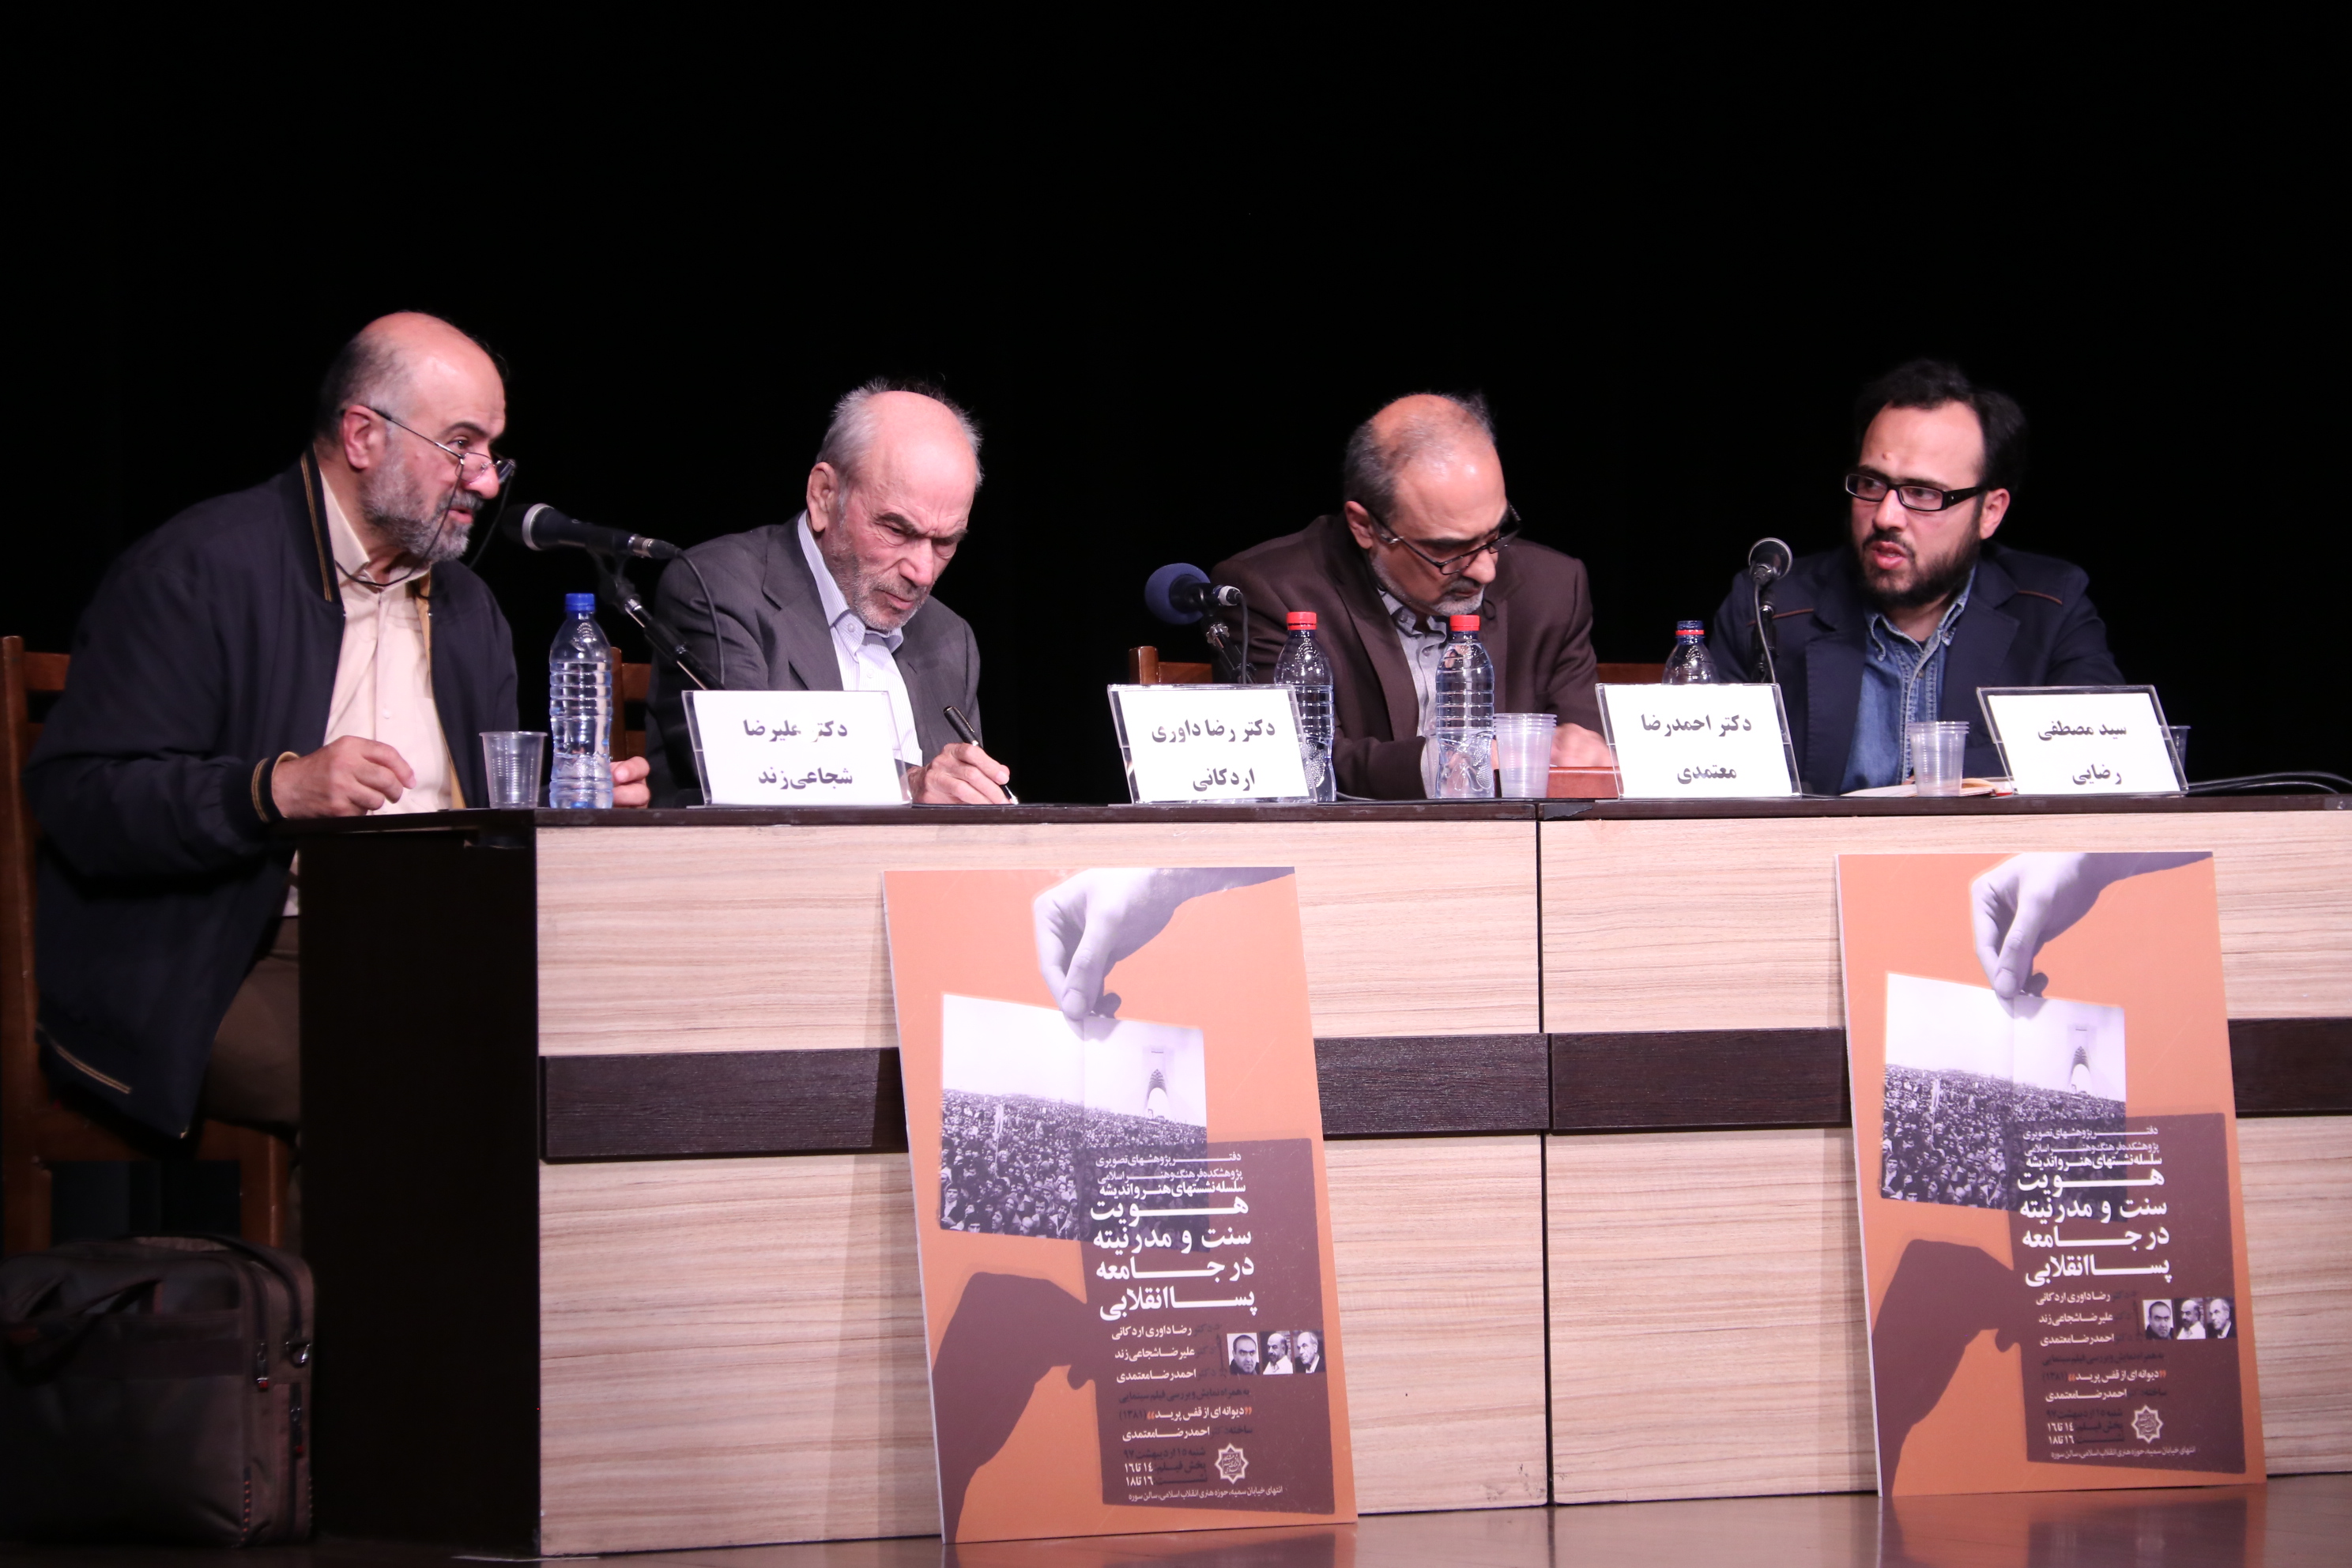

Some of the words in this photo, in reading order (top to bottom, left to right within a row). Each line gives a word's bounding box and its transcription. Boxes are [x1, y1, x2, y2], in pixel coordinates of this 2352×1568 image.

[743, 719, 801, 742] علیرضا
[1152, 719, 1201, 743] داوری
[1204, 719, 1236, 742] رضا
[1242, 719, 1276, 742] دکتر
[1640, 714, 1712, 737] احمدرضا
[1718, 714, 1752, 737] دکتر
[2037, 721, 2094, 741] مصطفی
[2099, 723, 2127, 740] سید
[1193, 767, 1256, 791] اردکانی
[1677, 764, 1737, 785] معتمدی
[2072, 763, 2122, 785] رضایی
[1095, 1155, 1129, 1168] تصویری
[2026, 1155, 2056, 1170] اندیشه
[2134, 1153, 2162, 1165] سلسله
[1097, 1170, 1125, 1184] اسلامی
[1216, 1181, 1246, 1193] سلسله
[2017, 1168, 2165, 1197] هویت
[1099, 1183, 1133, 1200] اندیشه
[1091, 1196, 1249, 1227] هویت
[2020, 1197, 2093, 1224] مدرنیته
[2101, 1200, 2111, 1223] و
[2120, 1198, 2167, 1218] سنت
[1093, 1227, 1172, 1256] مدرنیته
[1181, 1230, 1193, 1254] و
[1201, 1227, 1252, 1248] سنت
[2022, 1226, 2142, 1251] جامعه
[2146, 1227, 2169, 1250] در
[1096, 1256, 1225, 1283] جامعه
[1229, 1257, 1254, 1281] در
[2036, 1292, 2066, 1306] اردکانی
[2067, 1291, 2091, 1303] داوری
[2092, 1291, 2111, 1302] رضا
[1111, 1326, 1144, 1340] اردکانی
[1145, 1325, 1171, 1337] داوری
[1172, 1325, 1192, 1336] رضا
[1159, 1346, 1195, 1359] علیرضا
[1117, 1372, 1150, 1383] معتمدی
[1182, 1406, 1202, 1421] قفس
[1122, 1429, 1155, 1442] معتمدی
